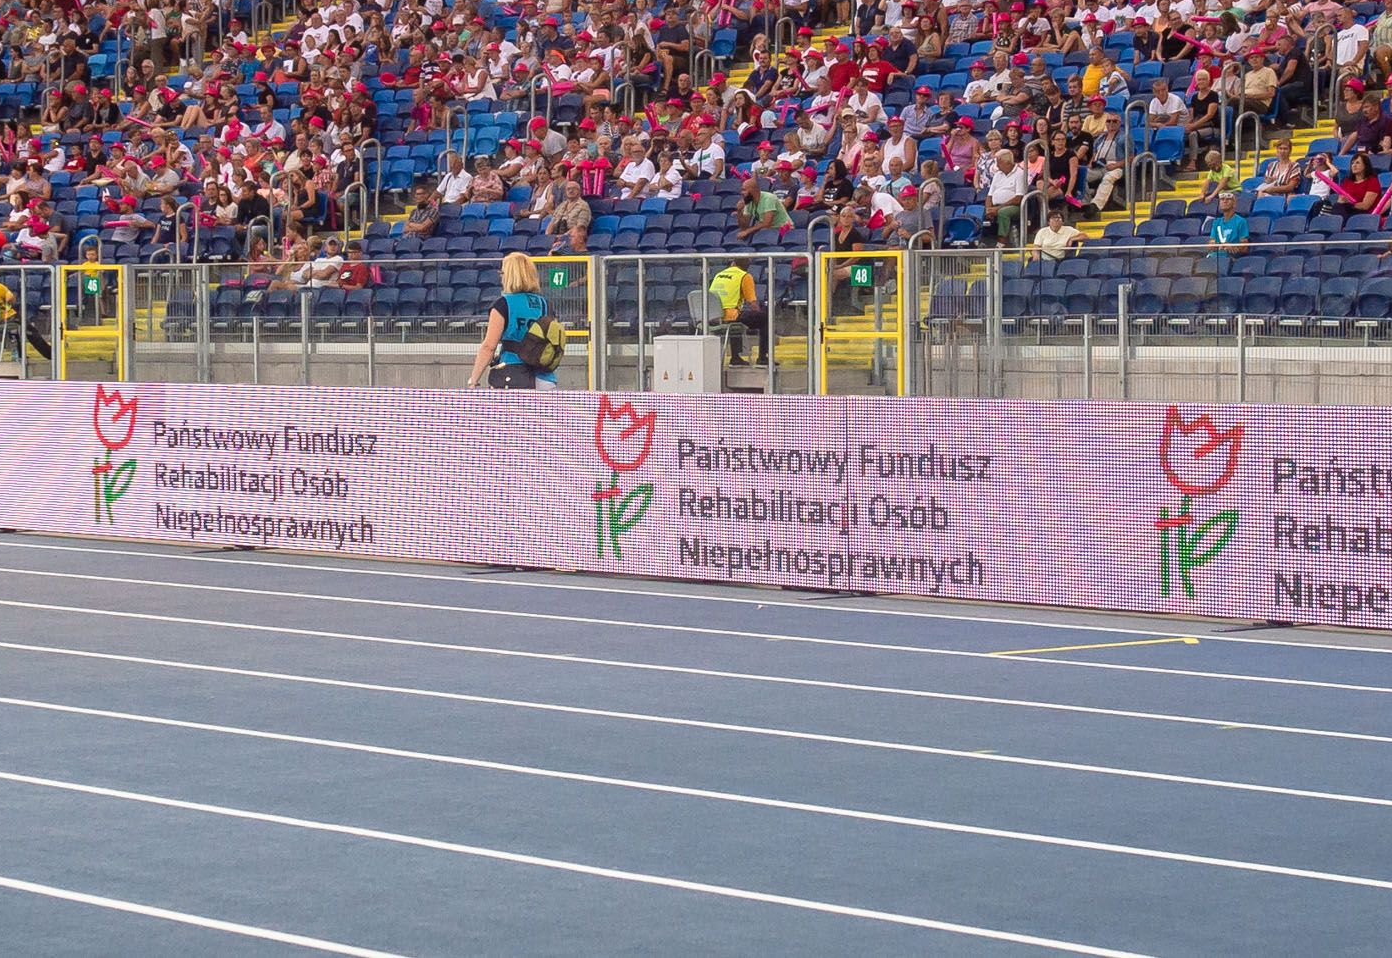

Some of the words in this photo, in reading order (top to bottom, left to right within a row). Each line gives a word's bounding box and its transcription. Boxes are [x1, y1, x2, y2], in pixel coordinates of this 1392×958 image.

[87, 279, 97, 292] 46
[553, 272, 564, 285] 47
[855, 268, 867, 283] 48
[154, 419, 276, 460] Państwowy
[284, 425, 378, 455] Fundusz
[677, 437, 848, 484] Państwowy
[861, 444, 991, 481] Fundusz
[155, 463, 284, 501] Rehabilitacji
[291, 467, 349, 498] Osób
[156, 502, 373, 550] Niepełnosprawnych
[679, 487, 858, 535] Rehabilitacji
[868, 495, 948, 530] Osób
[680, 537, 983, 593] Niepełnosprawnych
